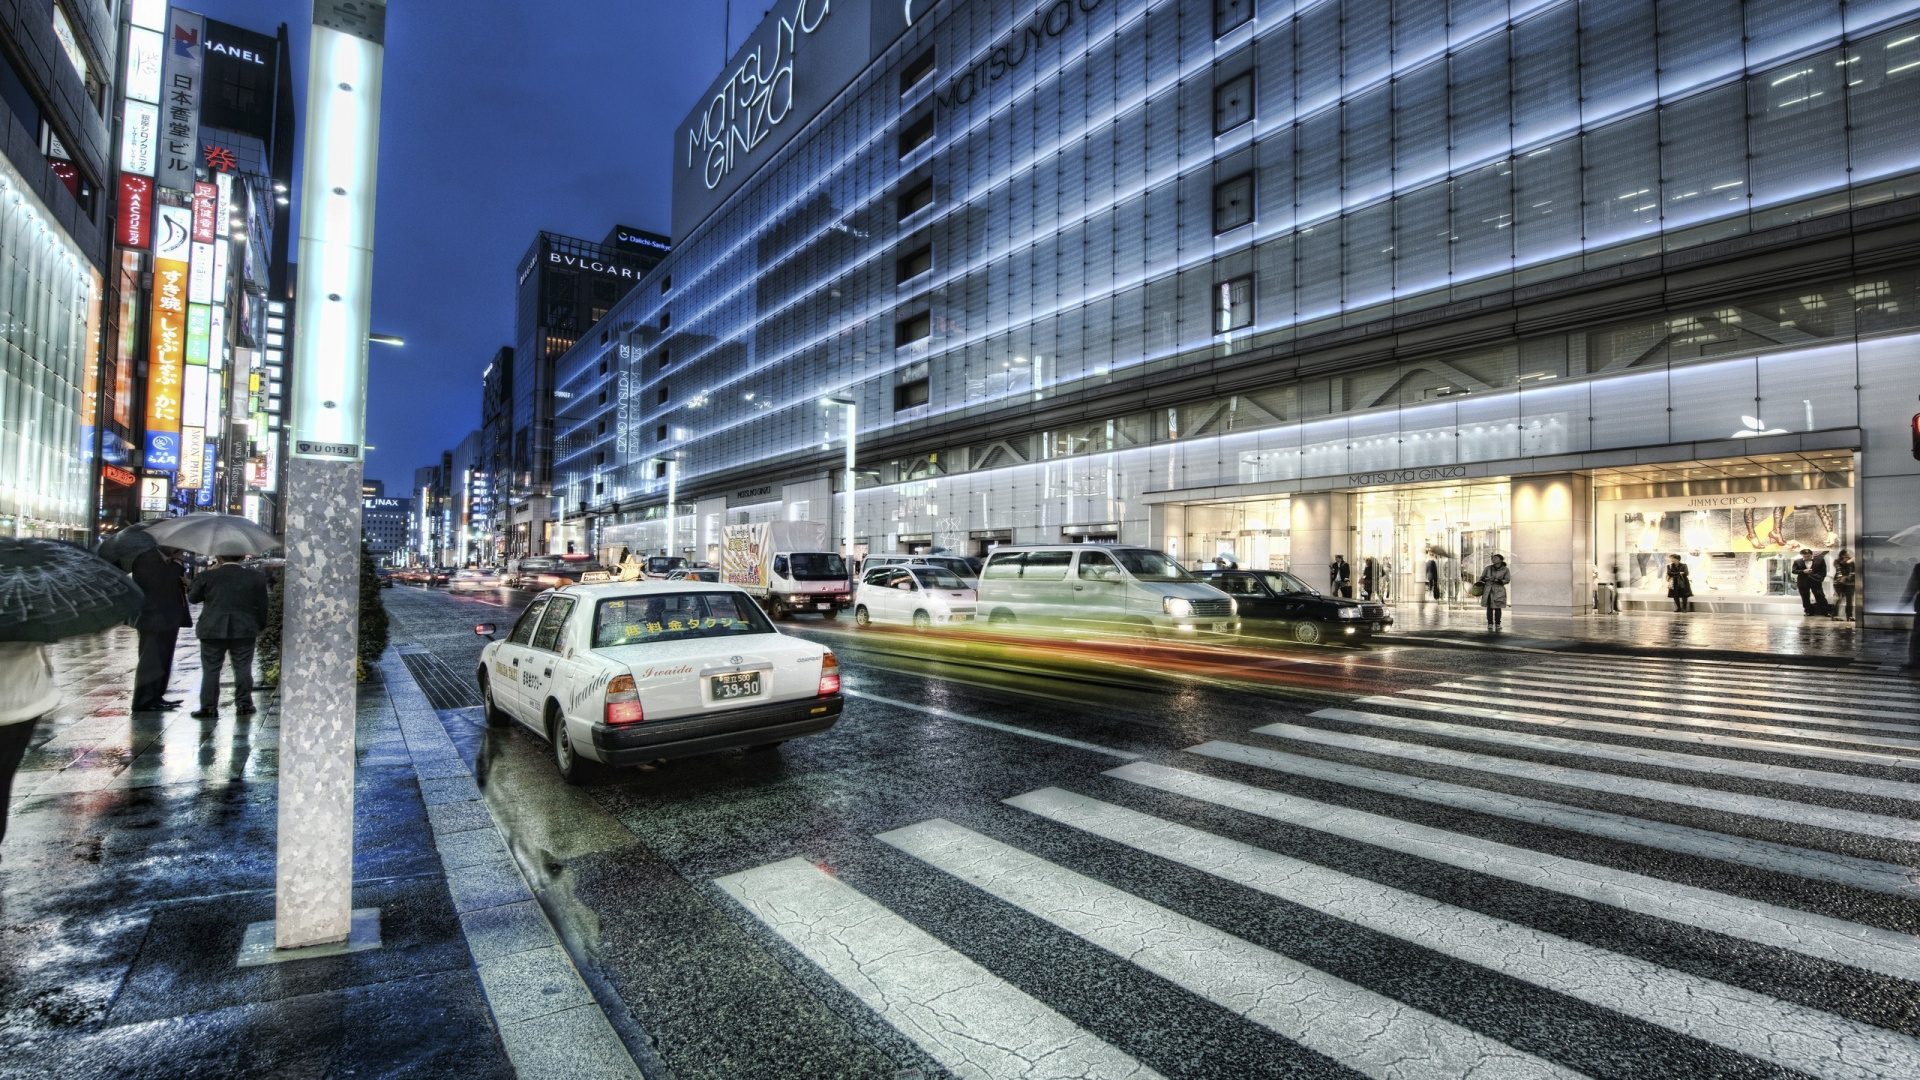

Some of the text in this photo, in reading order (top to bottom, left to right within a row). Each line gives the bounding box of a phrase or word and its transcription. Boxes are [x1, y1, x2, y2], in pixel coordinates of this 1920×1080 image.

[204, 40, 264, 65] HANEL
[168, 73, 193, 171] 日本香堂ビル
[550, 252, 642, 280] BVLGARI
[188, 429, 201, 488] MOON PHASE
[201, 449, 213, 502] CHAUMET
[375, 498, 399, 506] INAX
[1688, 496, 1757, 507] JIMMY CHOO
[624, 617, 749, 636] 低料金タクシー
[642, 664, 693, 678] Iwaida
[737, 674, 751, 682] 500
[567, 667, 611, 714] Iwaida
[722, 681, 759, 698] 39-90
